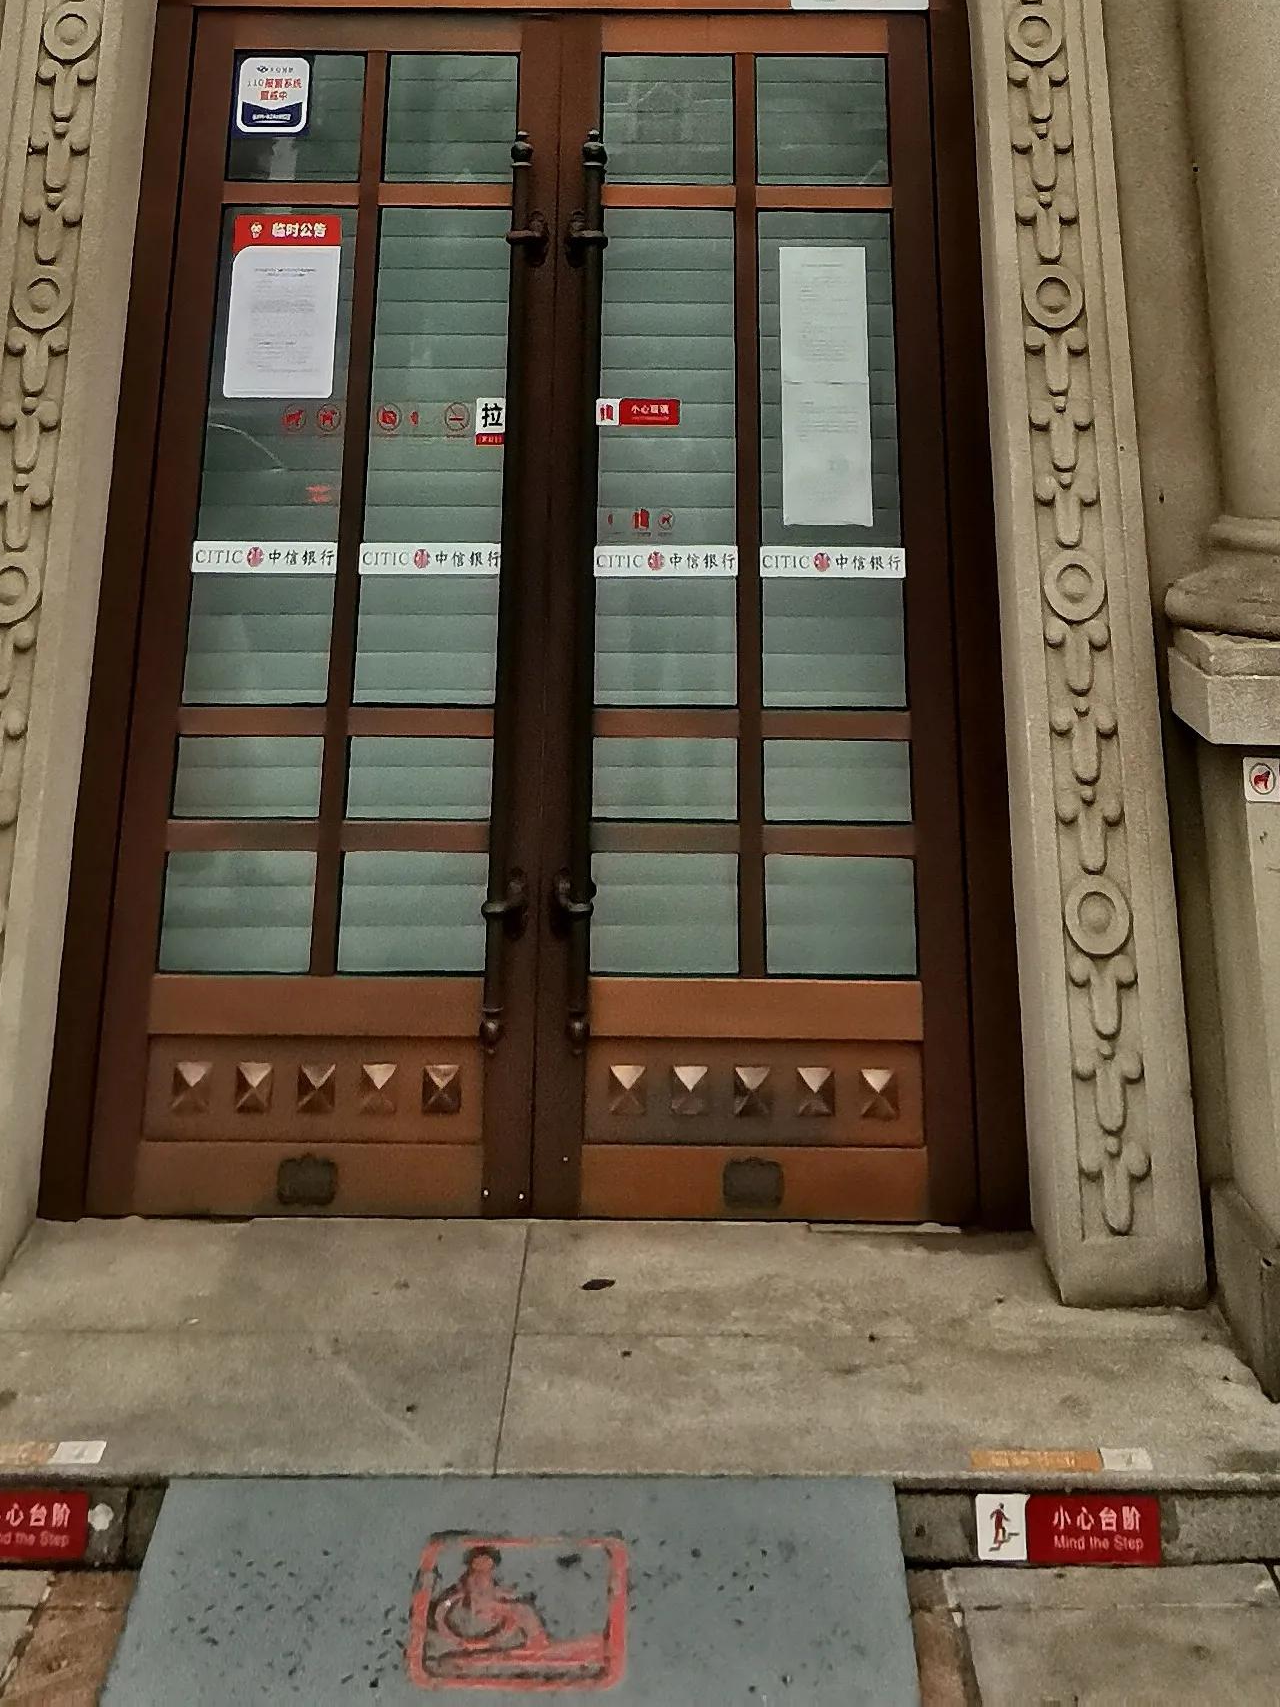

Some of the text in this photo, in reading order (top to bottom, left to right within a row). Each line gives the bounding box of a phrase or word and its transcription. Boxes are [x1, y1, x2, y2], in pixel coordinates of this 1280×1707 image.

[271, 222, 327, 238] 临时公告
[481, 402, 503, 428] 拉
[195, 550, 243, 564] CITIC
[268, 549, 335, 566] 中信银行
[362, 551, 410, 566] CITIC
[435, 549, 502, 568] 中信银行
[596, 553, 644, 568] CITIC
[669, 552, 736, 569] 中信银行
[762, 554, 810, 570] CITIC
[835, 553, 902, 570] 中信银行
[1052, 1506, 1141, 1532] 小心台阶
[1054, 1535, 1144, 1553] Mind the Step
